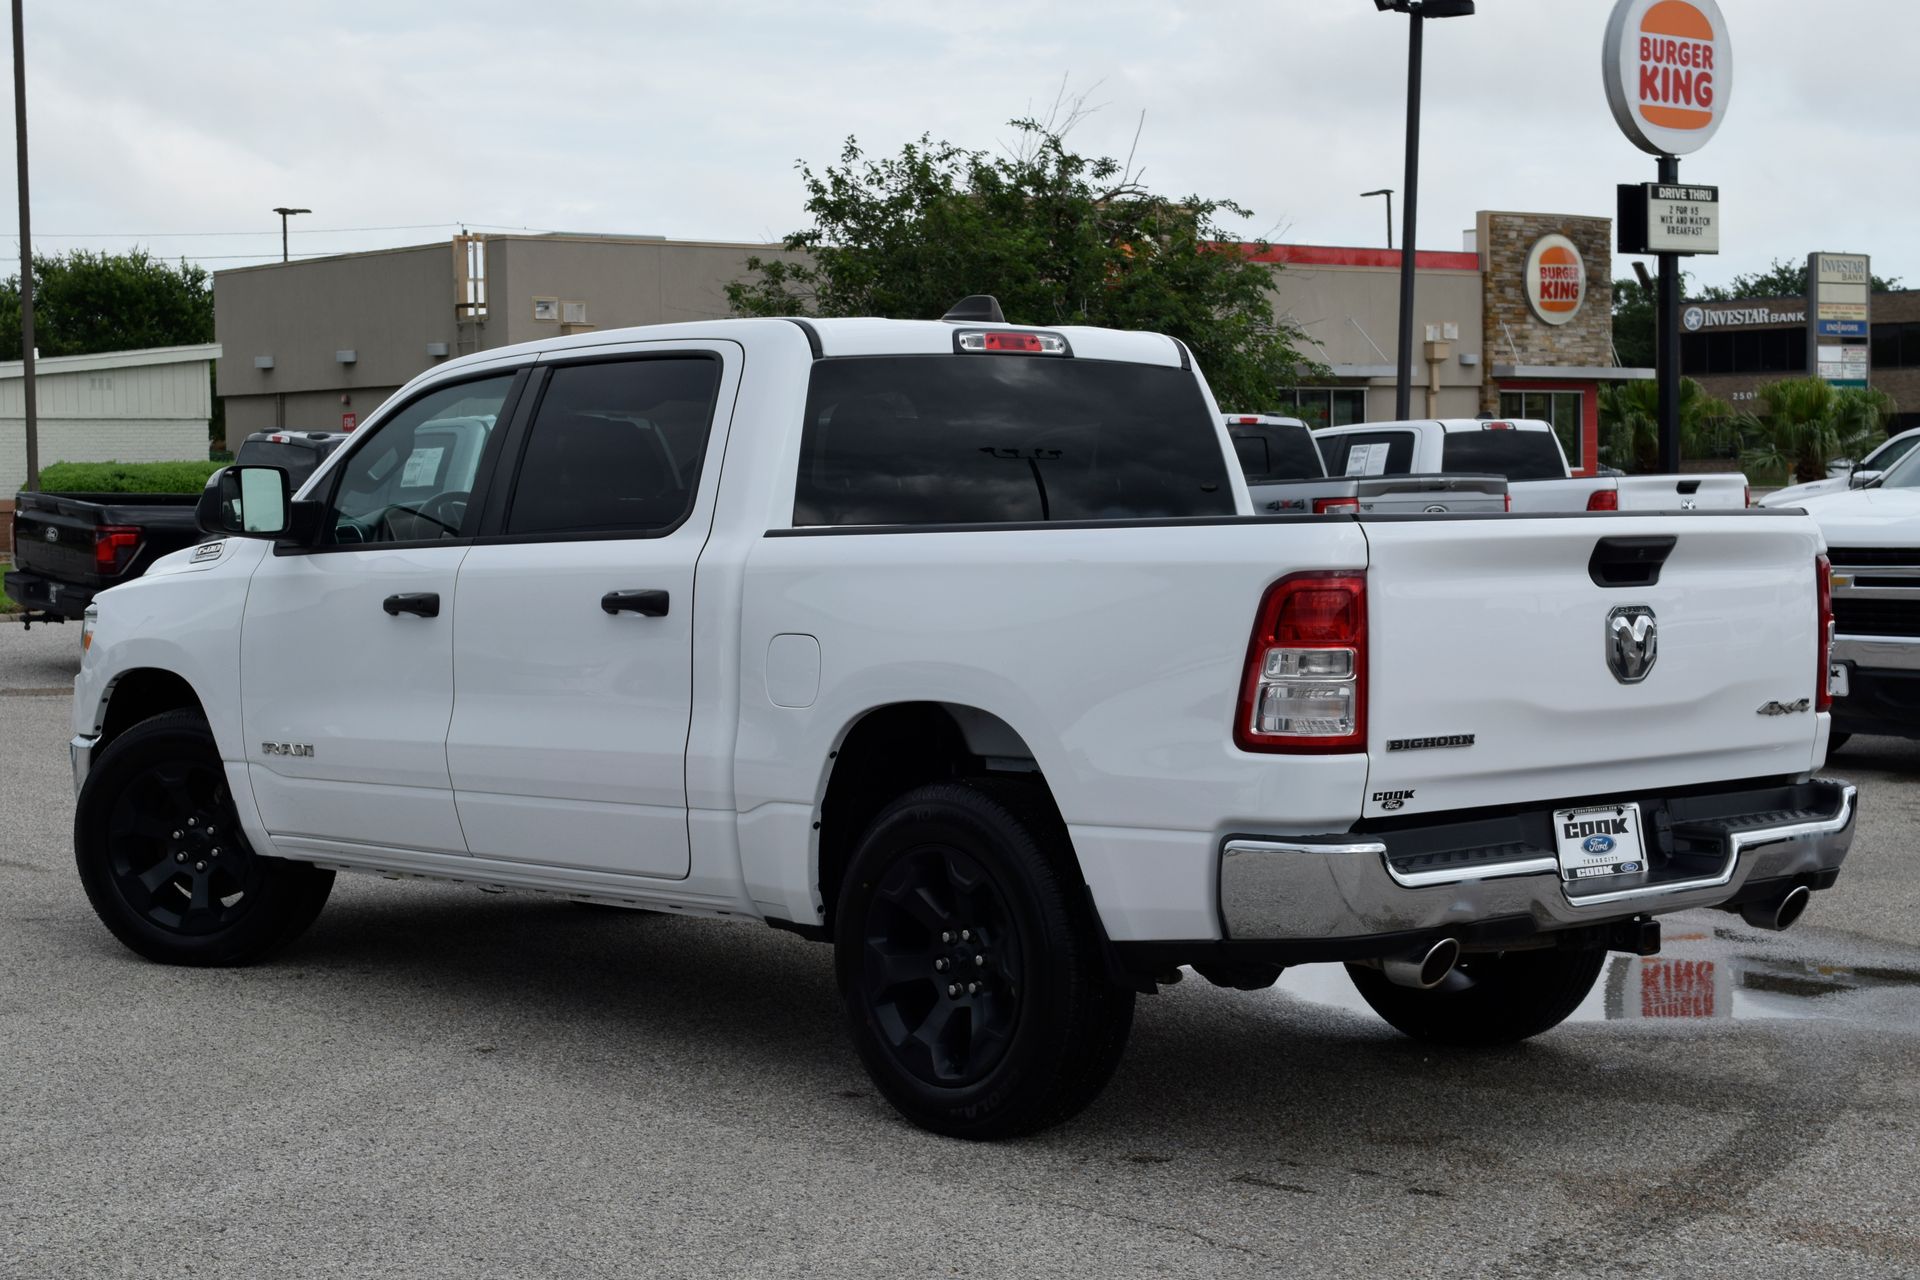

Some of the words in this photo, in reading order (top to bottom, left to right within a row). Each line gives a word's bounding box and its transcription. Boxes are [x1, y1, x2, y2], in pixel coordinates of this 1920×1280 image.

[1639, 36, 1714, 70] BURGER
[1639, 63, 1714, 108] KING
[1658, 187, 1687, 199] DRIVE
[1688, 189, 1712, 201] THRU
[1669, 205, 1674, 215] 2
[1675, 205, 1688, 215] FOR
[1660, 215, 1673, 225] MIX
[1676, 216, 1688, 225] AND
[1689, 216, 1711, 226] MATCH
[1666, 225, 1703, 236] BREAKFAST
[1821, 257, 1864, 273] INVESTAR
[1540, 266, 1579, 280] BURGER
[1841, 272, 1865, 282] BANK
[1540, 281, 1579, 300] KING
[1703, 307, 1770, 327] INVESTAR
[1770, 311, 1806, 323] BANK
[1387, 733, 1475, 752] BIGHORN
[1372, 789, 1416, 802] COOK
[1384, 800, 1402, 810] Ford
[1563, 817, 1630, 840] COOK
[1587, 837, 1609, 853] Ford
[1576, 864, 1614, 878] COOK
